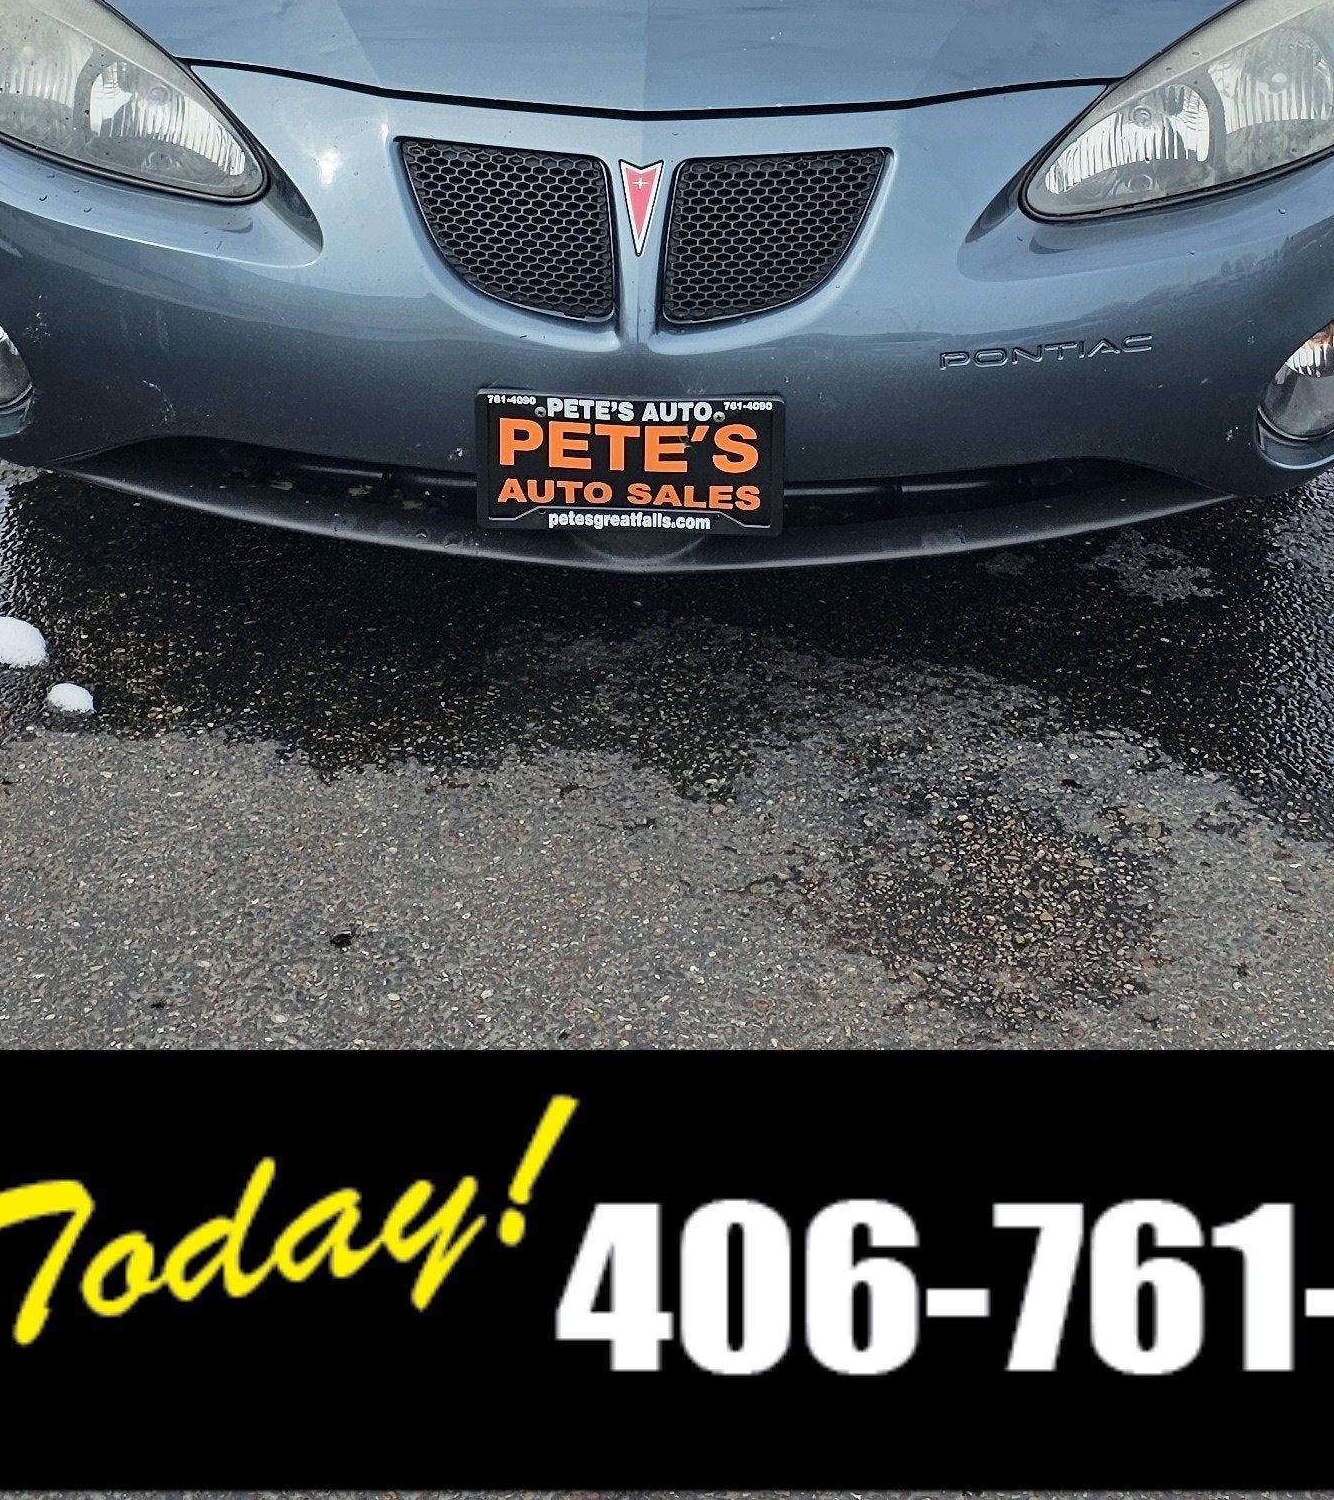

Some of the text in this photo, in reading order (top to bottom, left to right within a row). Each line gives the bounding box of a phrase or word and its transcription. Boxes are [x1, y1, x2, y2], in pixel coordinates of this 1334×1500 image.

[938, 333, 1153, 371] PONTIAC
[487, 394, 537, 406] 761-4090
[546, 397, 713, 422] PETE'S AUTO
[723, 401, 773, 411] 761-4090
[499, 417, 759, 474] PETE'S
[497, 478, 761, 511] AUTO SALES
[548, 510, 711, 530] petesgreatfalls.com
